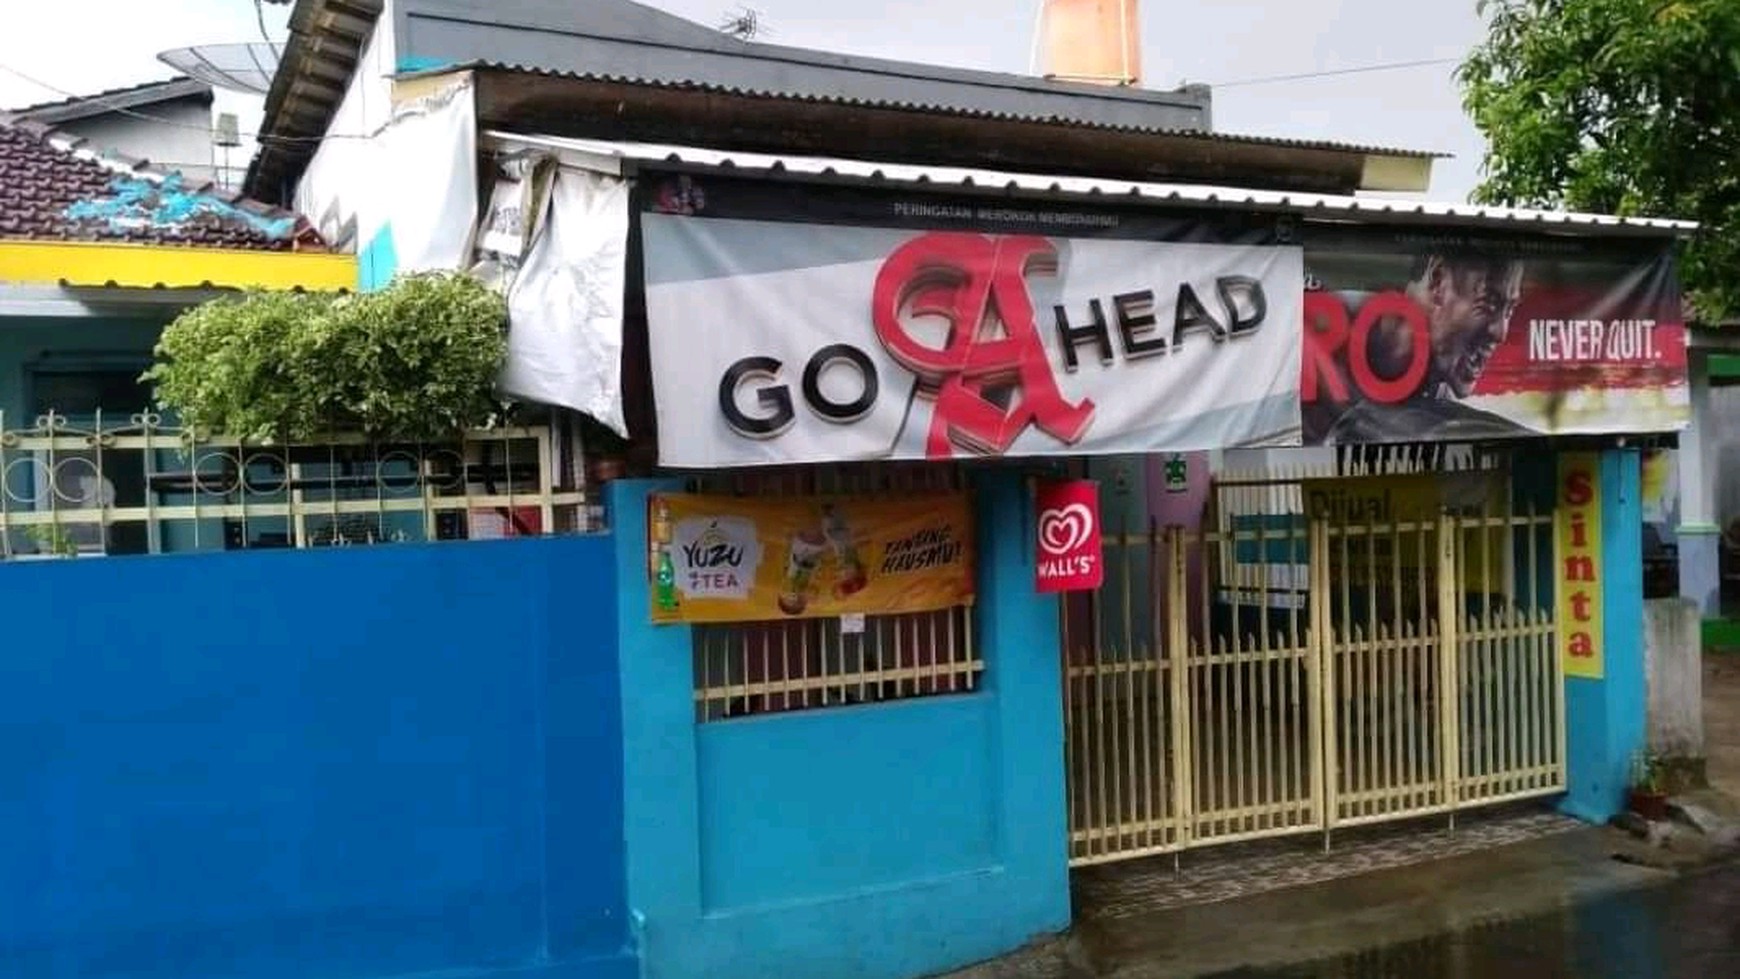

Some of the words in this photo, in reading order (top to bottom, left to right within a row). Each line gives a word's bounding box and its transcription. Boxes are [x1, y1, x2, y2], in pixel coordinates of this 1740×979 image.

[718, 343, 880, 441] GO
[1054, 274, 1268, 374] HEAD
[1529, 319, 1604, 361] NEVER
[1606, 319, 1663, 361] QUIT.
[682, 540, 744, 568] YUZU
[1037, 556, 1092, 577] WALL'S
[1564, 469, 1597, 658] Sinta
